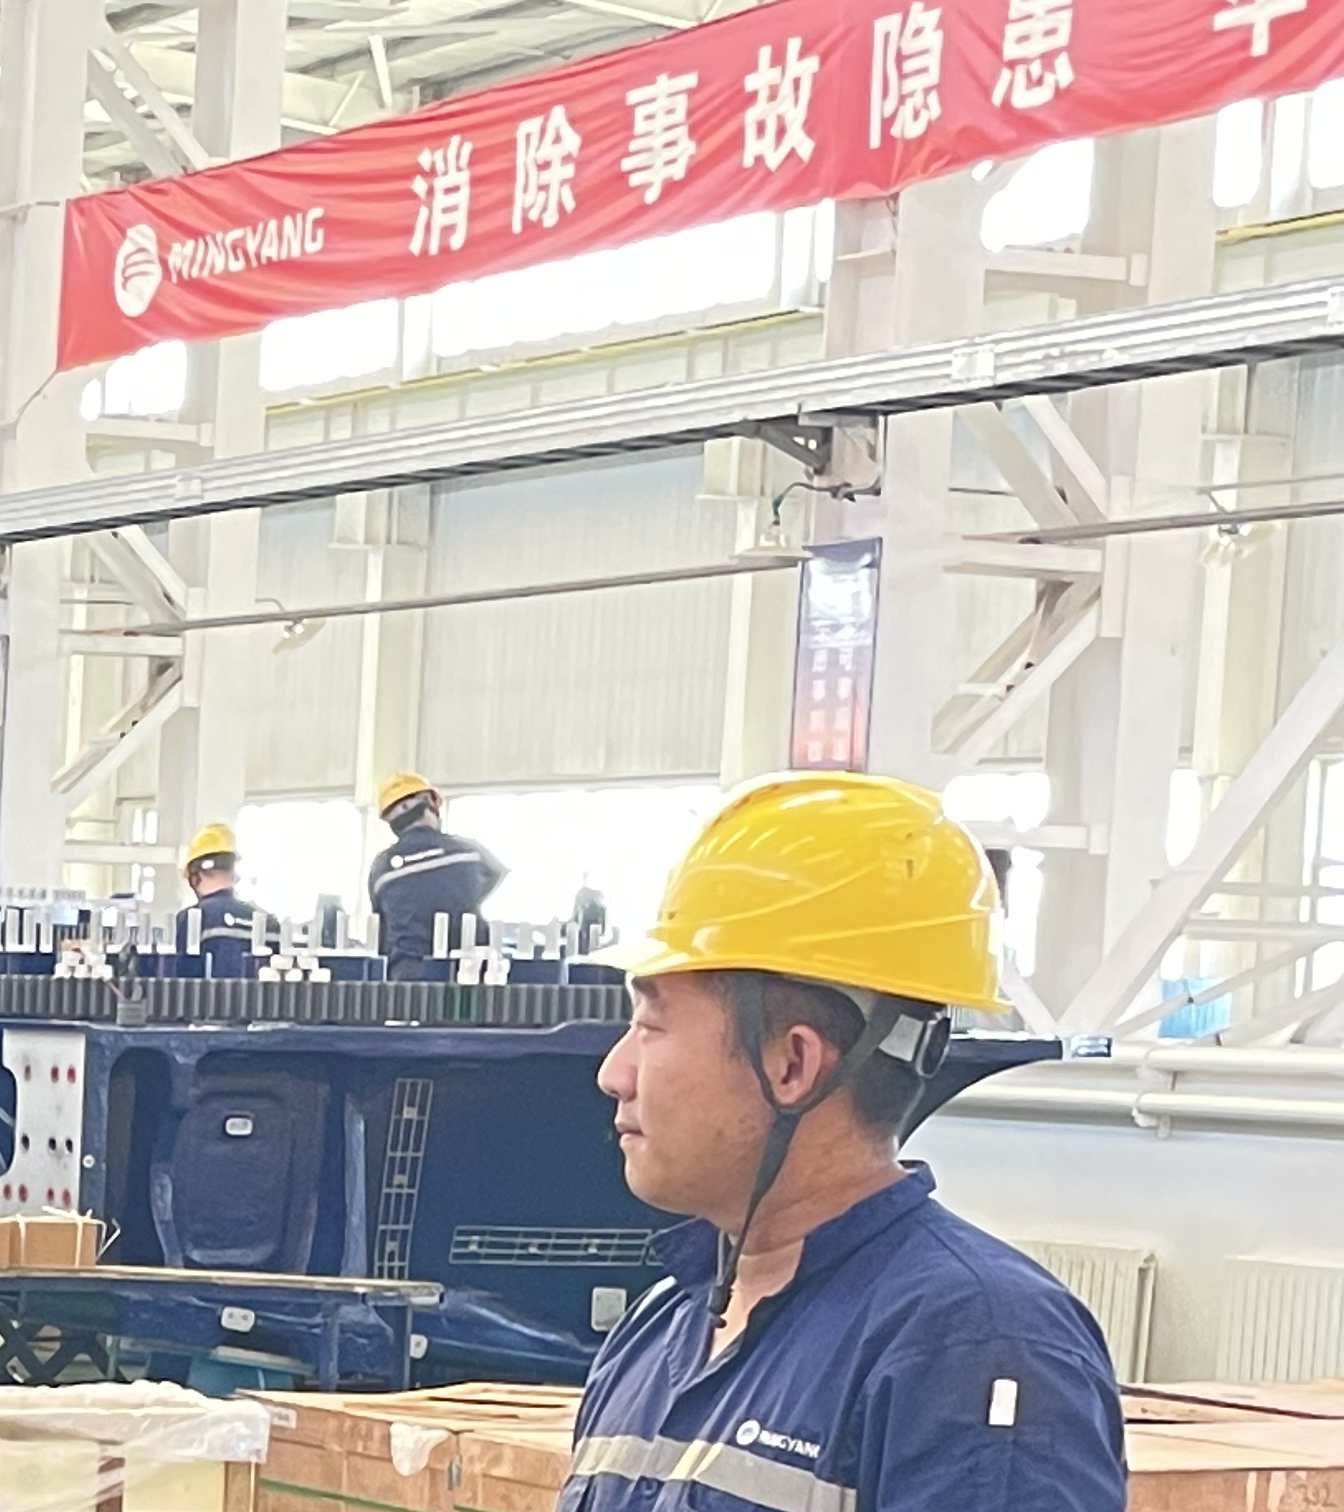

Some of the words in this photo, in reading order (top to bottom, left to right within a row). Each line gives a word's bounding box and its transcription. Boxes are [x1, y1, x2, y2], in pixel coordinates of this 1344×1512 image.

[408, 0, 1076, 258] 消除事故隐患
[167, 207, 325, 283] MINGYANG
